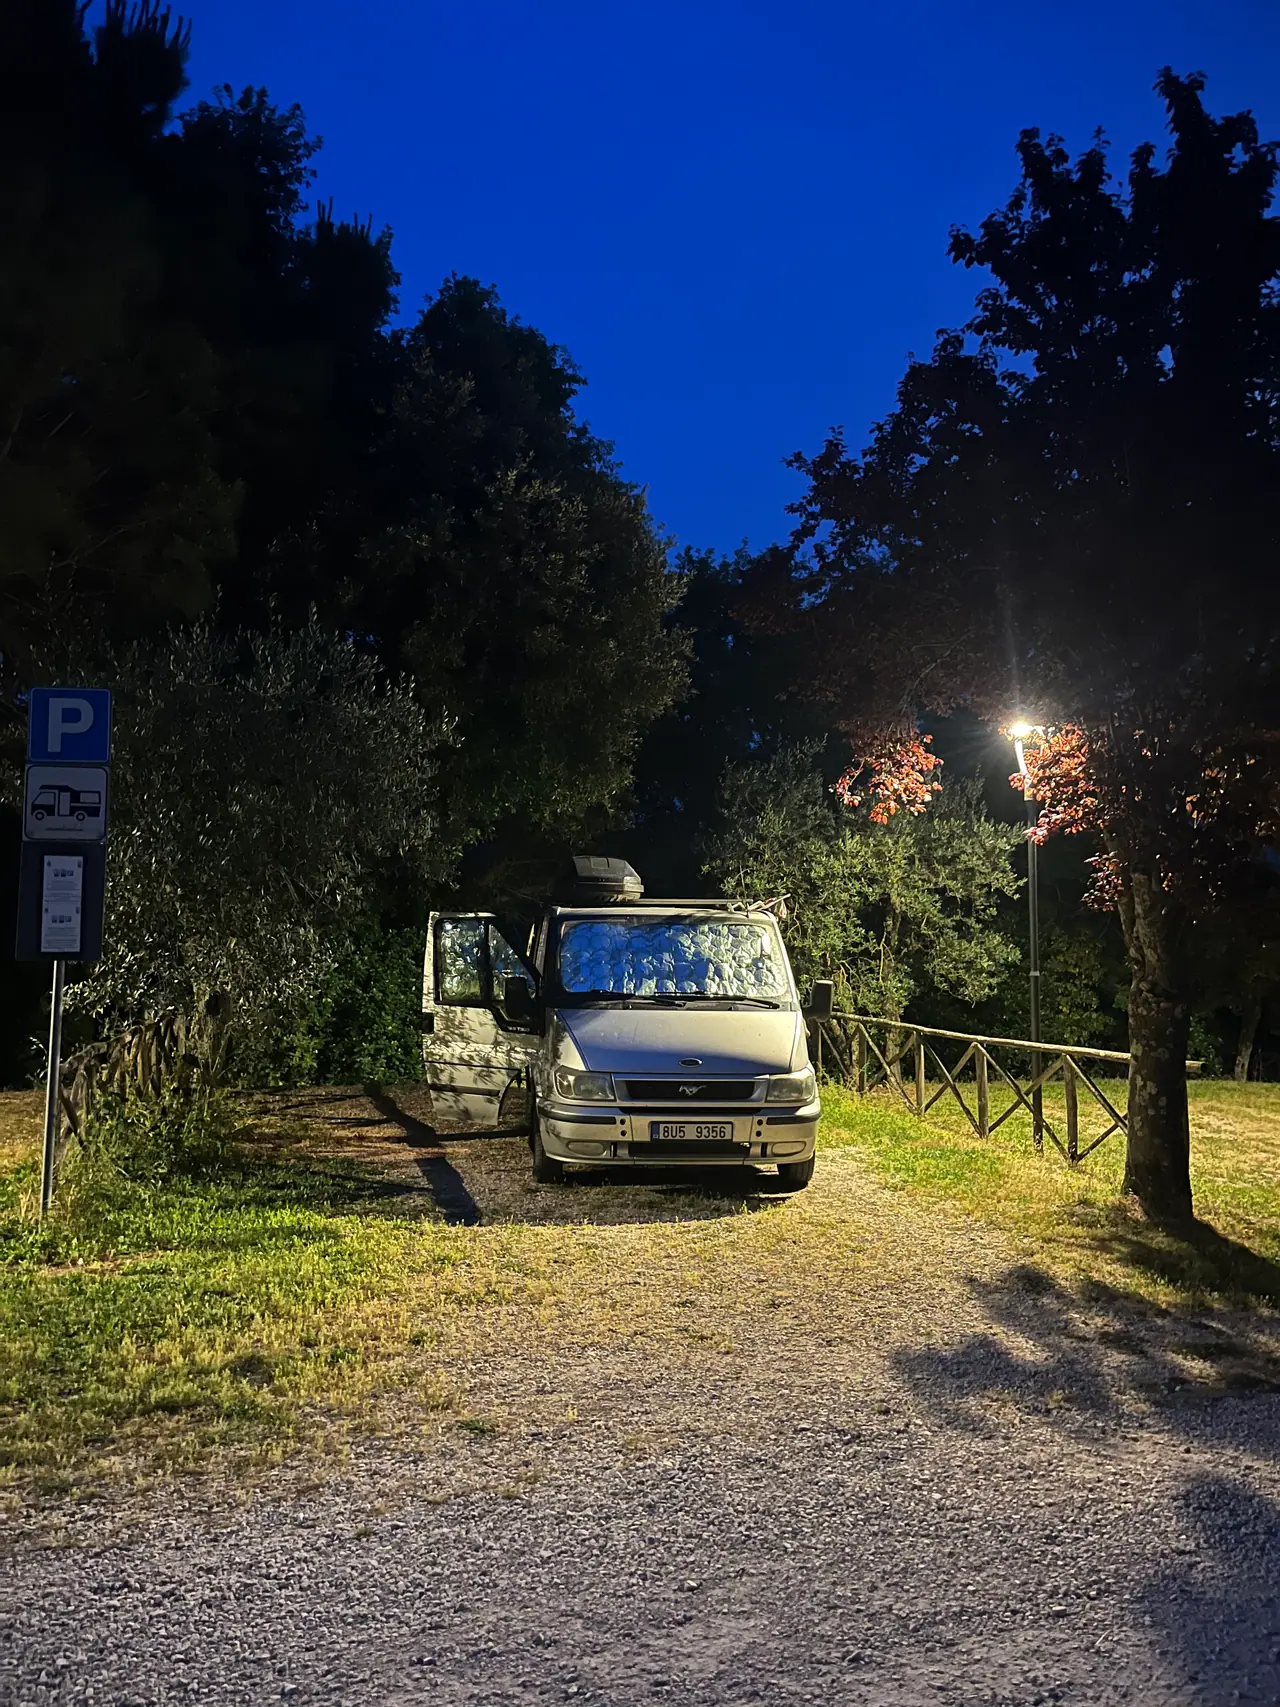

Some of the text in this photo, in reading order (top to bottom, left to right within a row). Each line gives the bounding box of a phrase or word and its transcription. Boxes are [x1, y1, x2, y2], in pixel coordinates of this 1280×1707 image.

[47, 697, 94, 753] P
[662, 1125, 686, 1139] 8U5
[695, 1125, 727, 1139] 9356
